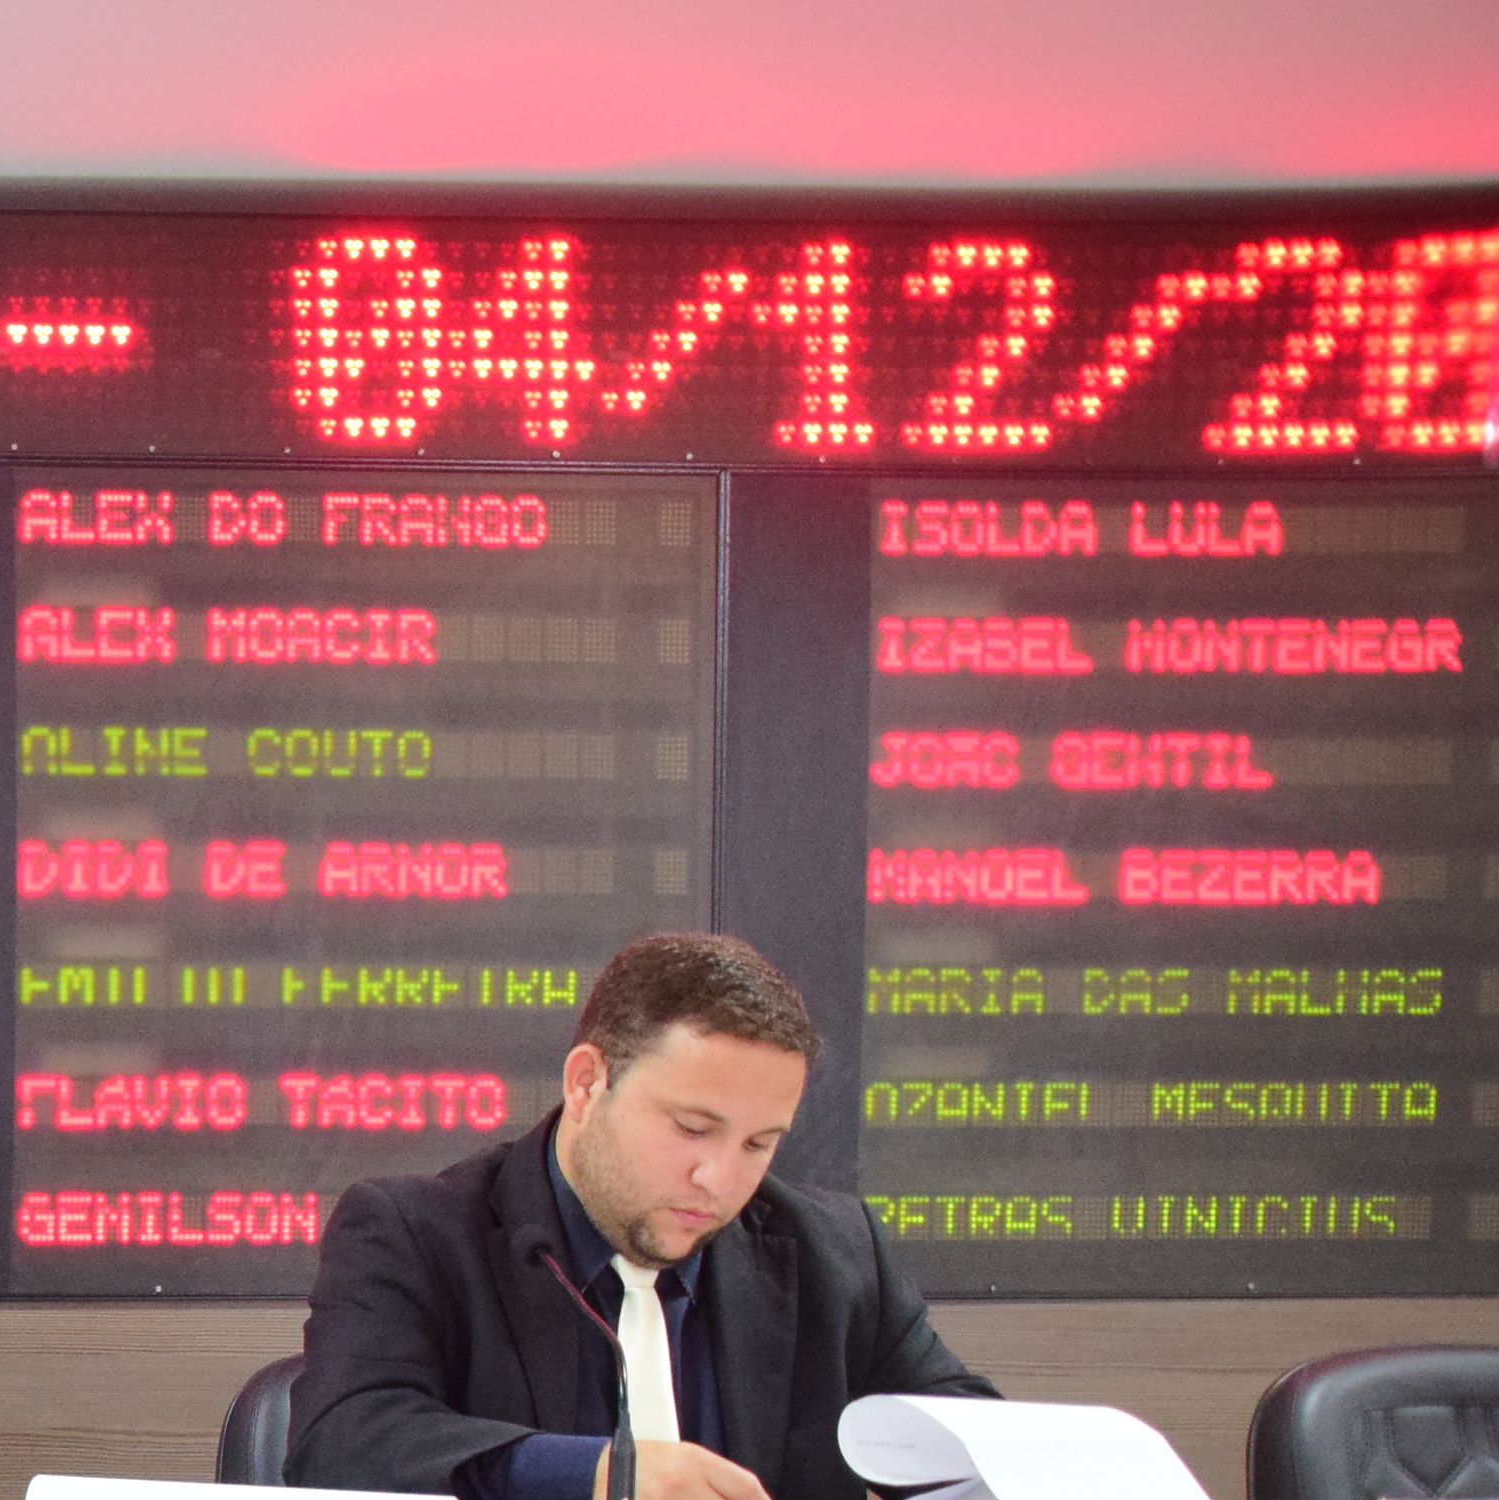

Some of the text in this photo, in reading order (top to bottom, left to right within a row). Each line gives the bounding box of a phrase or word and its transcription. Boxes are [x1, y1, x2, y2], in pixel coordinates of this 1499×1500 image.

[18, 488, 549, 548] ALEX DO FRANGO
[880, 500, 1285, 557] ISOLDA LULA
[17, 604, 437, 665] ALEX MOACIR
[246, 726, 433, 778] COUTO
[17, 838, 169, 900] DIDI
[205, 838, 287, 900] DE
[1120, 848, 1382, 905] BEZERRA
[867, 968, 1044, 1015] MARIA
[1083, 968, 1191, 1015] DAS
[279, 1073, 507, 1132] TACITO
